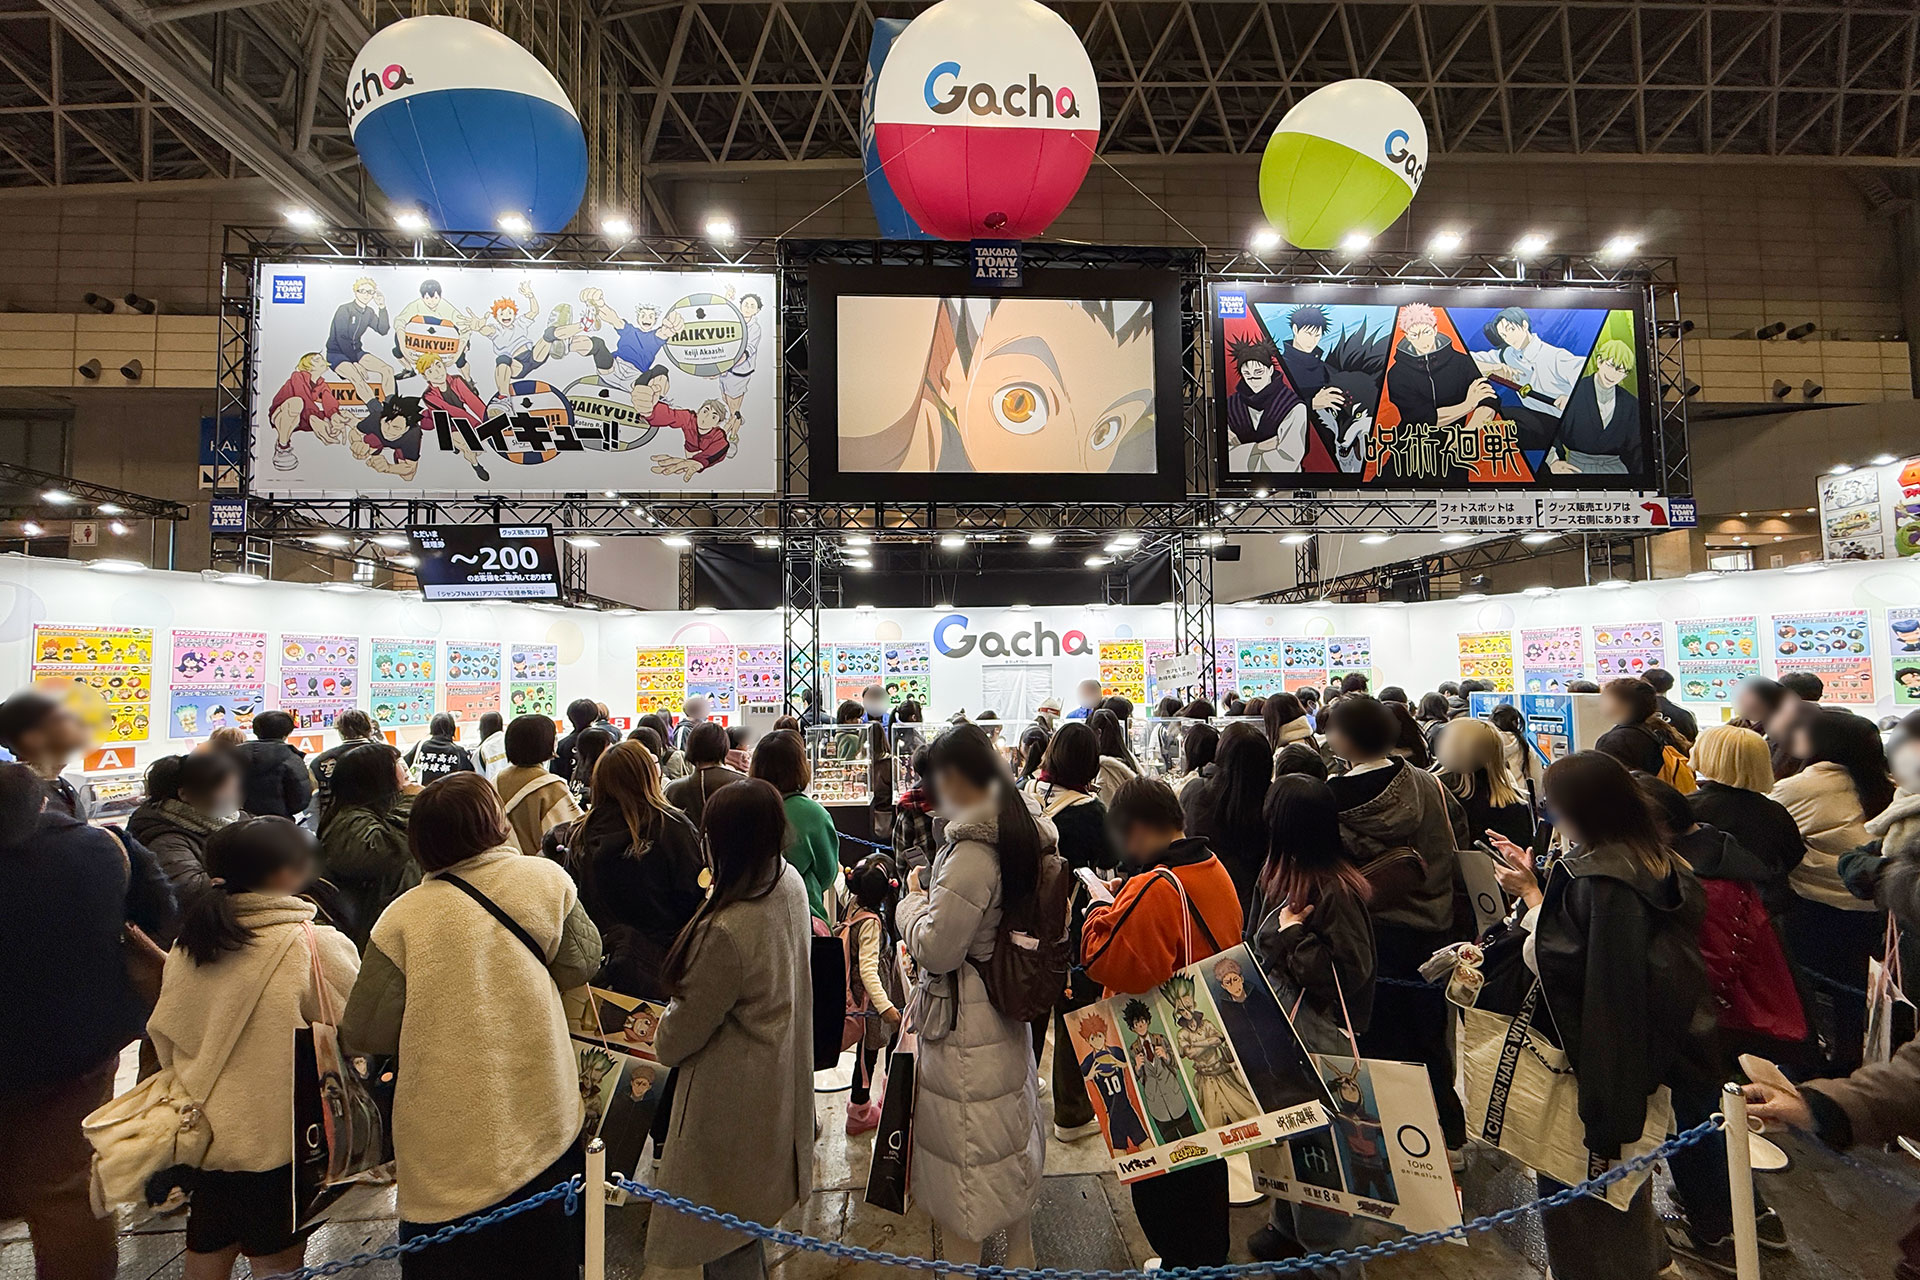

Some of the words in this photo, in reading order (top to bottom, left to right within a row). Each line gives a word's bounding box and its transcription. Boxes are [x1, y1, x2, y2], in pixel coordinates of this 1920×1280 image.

[924, 61, 1080, 119] Gacha
[1385, 129, 1424, 187] Gac
[975, 247, 1018, 257] TAKARA
[975, 256, 1018, 268] TOMY
[671, 327, 735, 342] HAIKYU!!
[405, 335, 455, 351] HAIKYU!!
[433, 411, 619, 451] ハイキュー!!
[1364, 422, 1522, 479] 呪術廻戦
[1440, 502, 1515, 513] フォトスポットは
[1549, 502, 1631, 513] グッズ販売エリアは
[212, 511, 243, 519] TOMY
[1440, 514, 1534, 526] ブース裏側にあります
[1549, 514, 1641, 526] ブース右側にあります
[933, 614, 1093, 659] Gacha
[614, 718, 625, 730] B
[712, 716, 724, 727] B
[298, 737, 315, 752] A
[97, 750, 123, 769] A
[1486, 1083, 1508, 1135] CHUMS!
[1497, 1044, 1519, 1085] HANG
[1508, 1011, 1530, 1043] WITH
[1104, 1075, 1122, 1096] 10
[1407, 1159, 1434, 1171] TOHO
[1401, 1168, 1443, 1181] animation
